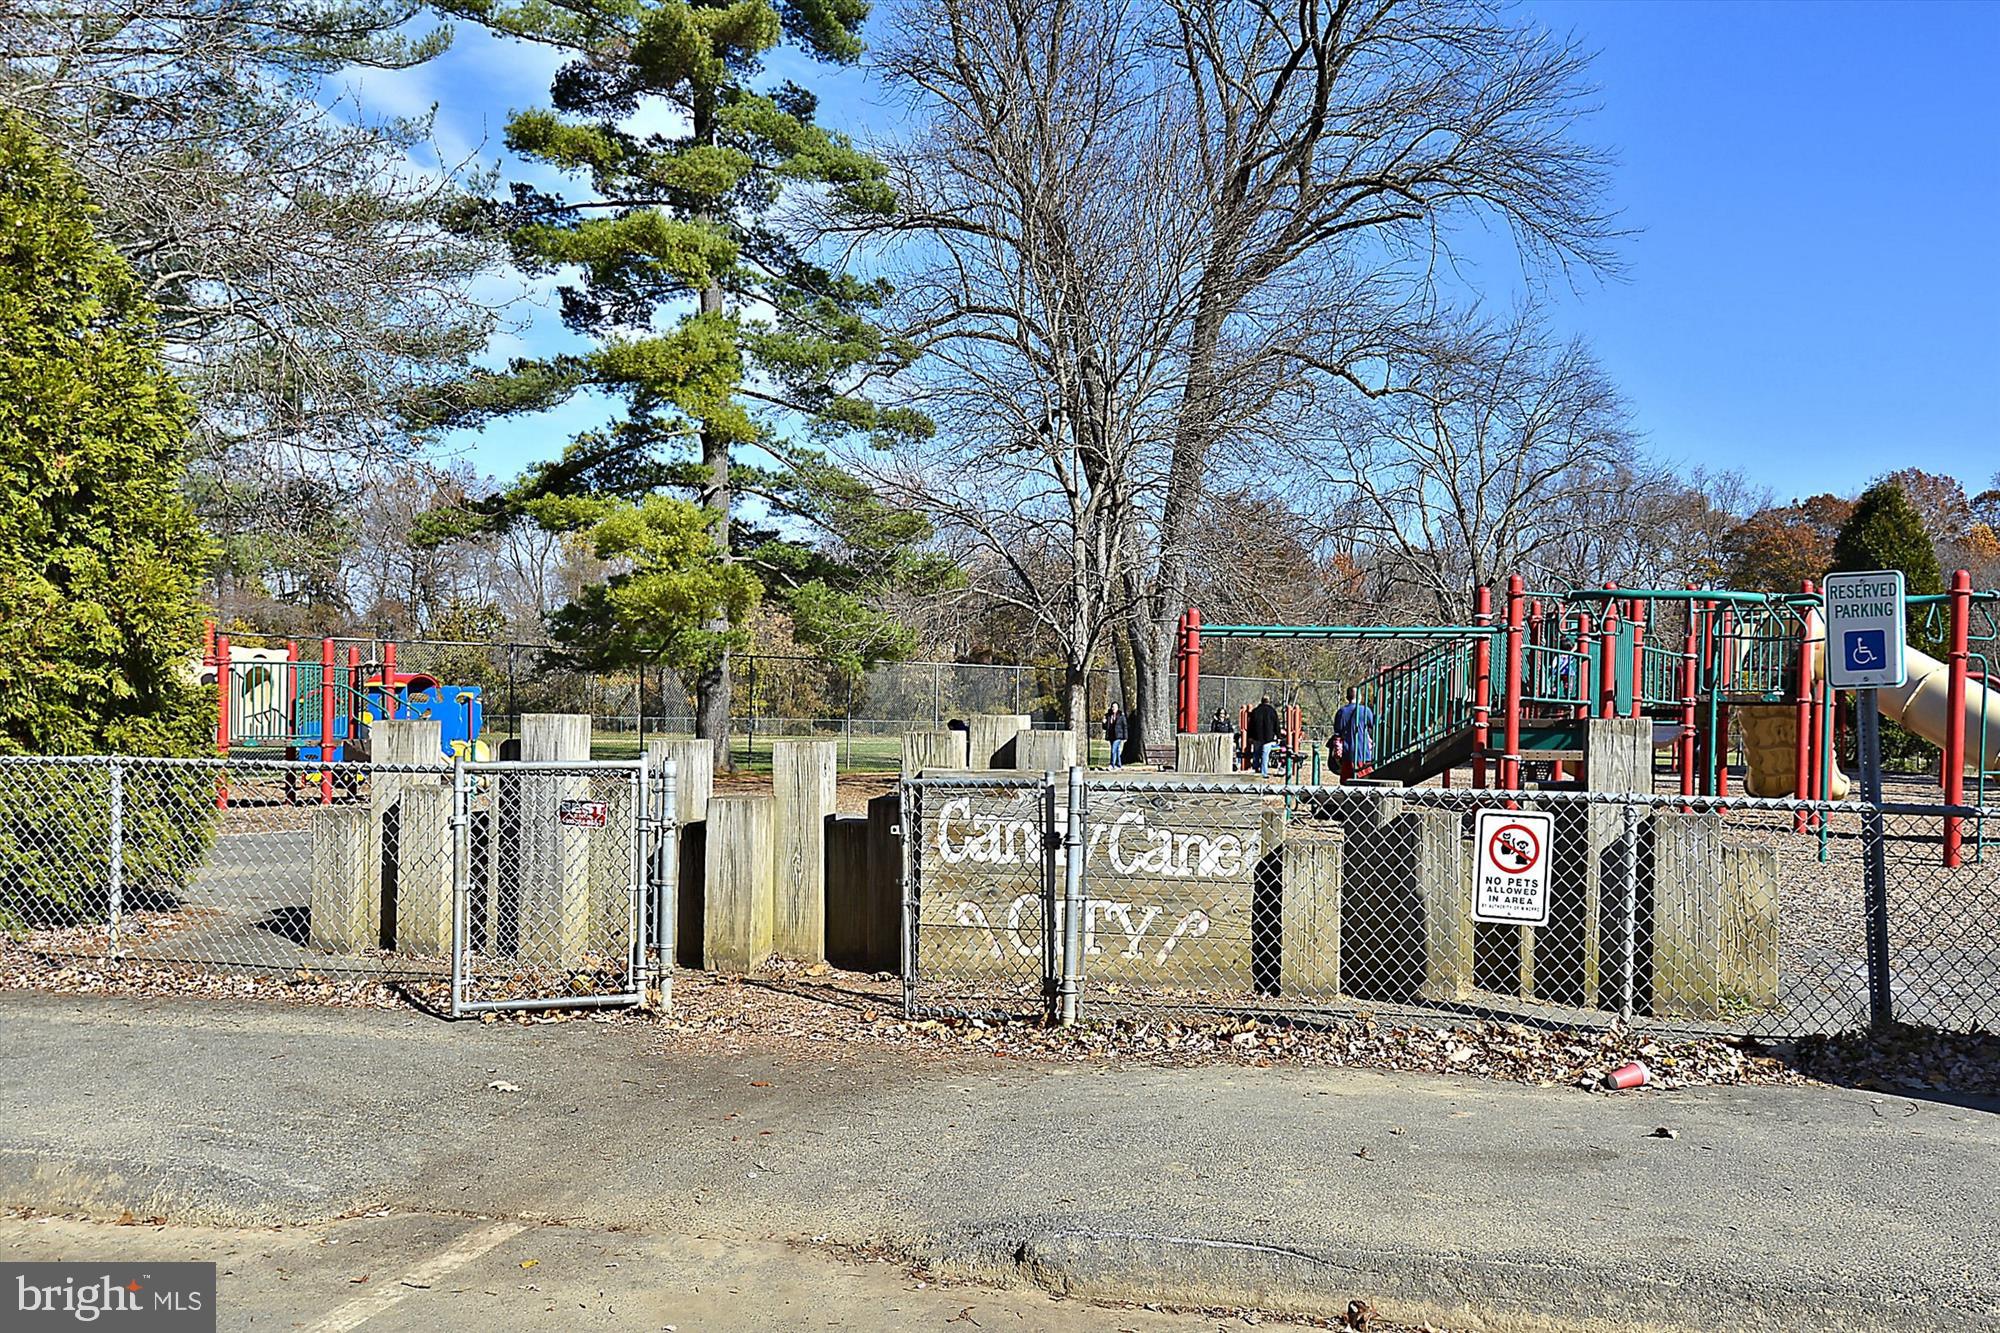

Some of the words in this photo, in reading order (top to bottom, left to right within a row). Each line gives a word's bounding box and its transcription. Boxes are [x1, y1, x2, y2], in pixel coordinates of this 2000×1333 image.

[1830, 583, 1897, 600] RESERVED
[1834, 602, 1894, 619] PARKING
[1107, 809, 1242, 878] Cane
[1485, 876, 1502, 886] NO
[1507, 877, 1539, 889] PETS
[1486, 886, 1537, 896] ALLOWED
[1488, 895, 1499, 903] IN
[1504, 896, 1533, 905] AREA
